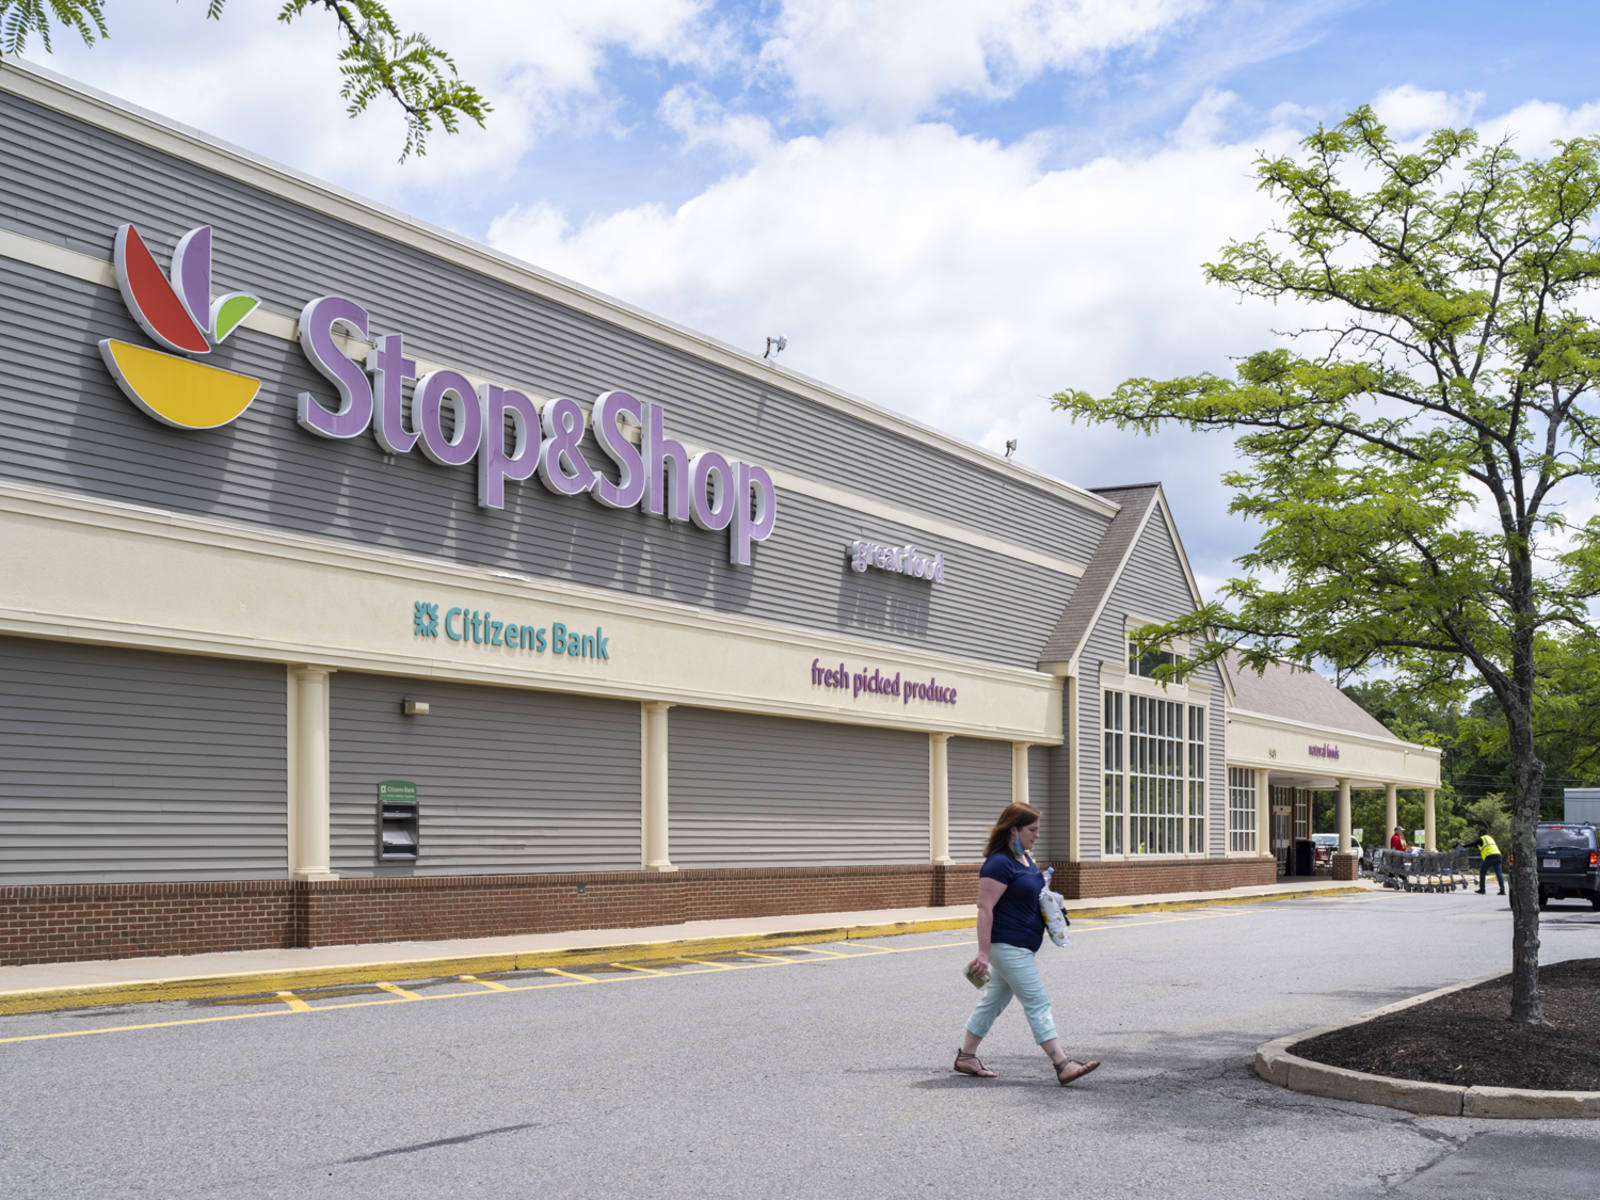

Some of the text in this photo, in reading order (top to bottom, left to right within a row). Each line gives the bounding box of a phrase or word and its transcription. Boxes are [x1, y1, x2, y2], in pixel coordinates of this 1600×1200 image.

[852, 540, 945, 583] great food
[445, 606, 610, 661] Citizens Bank
[811, 657, 958, 705] fresh picked produce
[1308, 743, 1327, 758] natural
